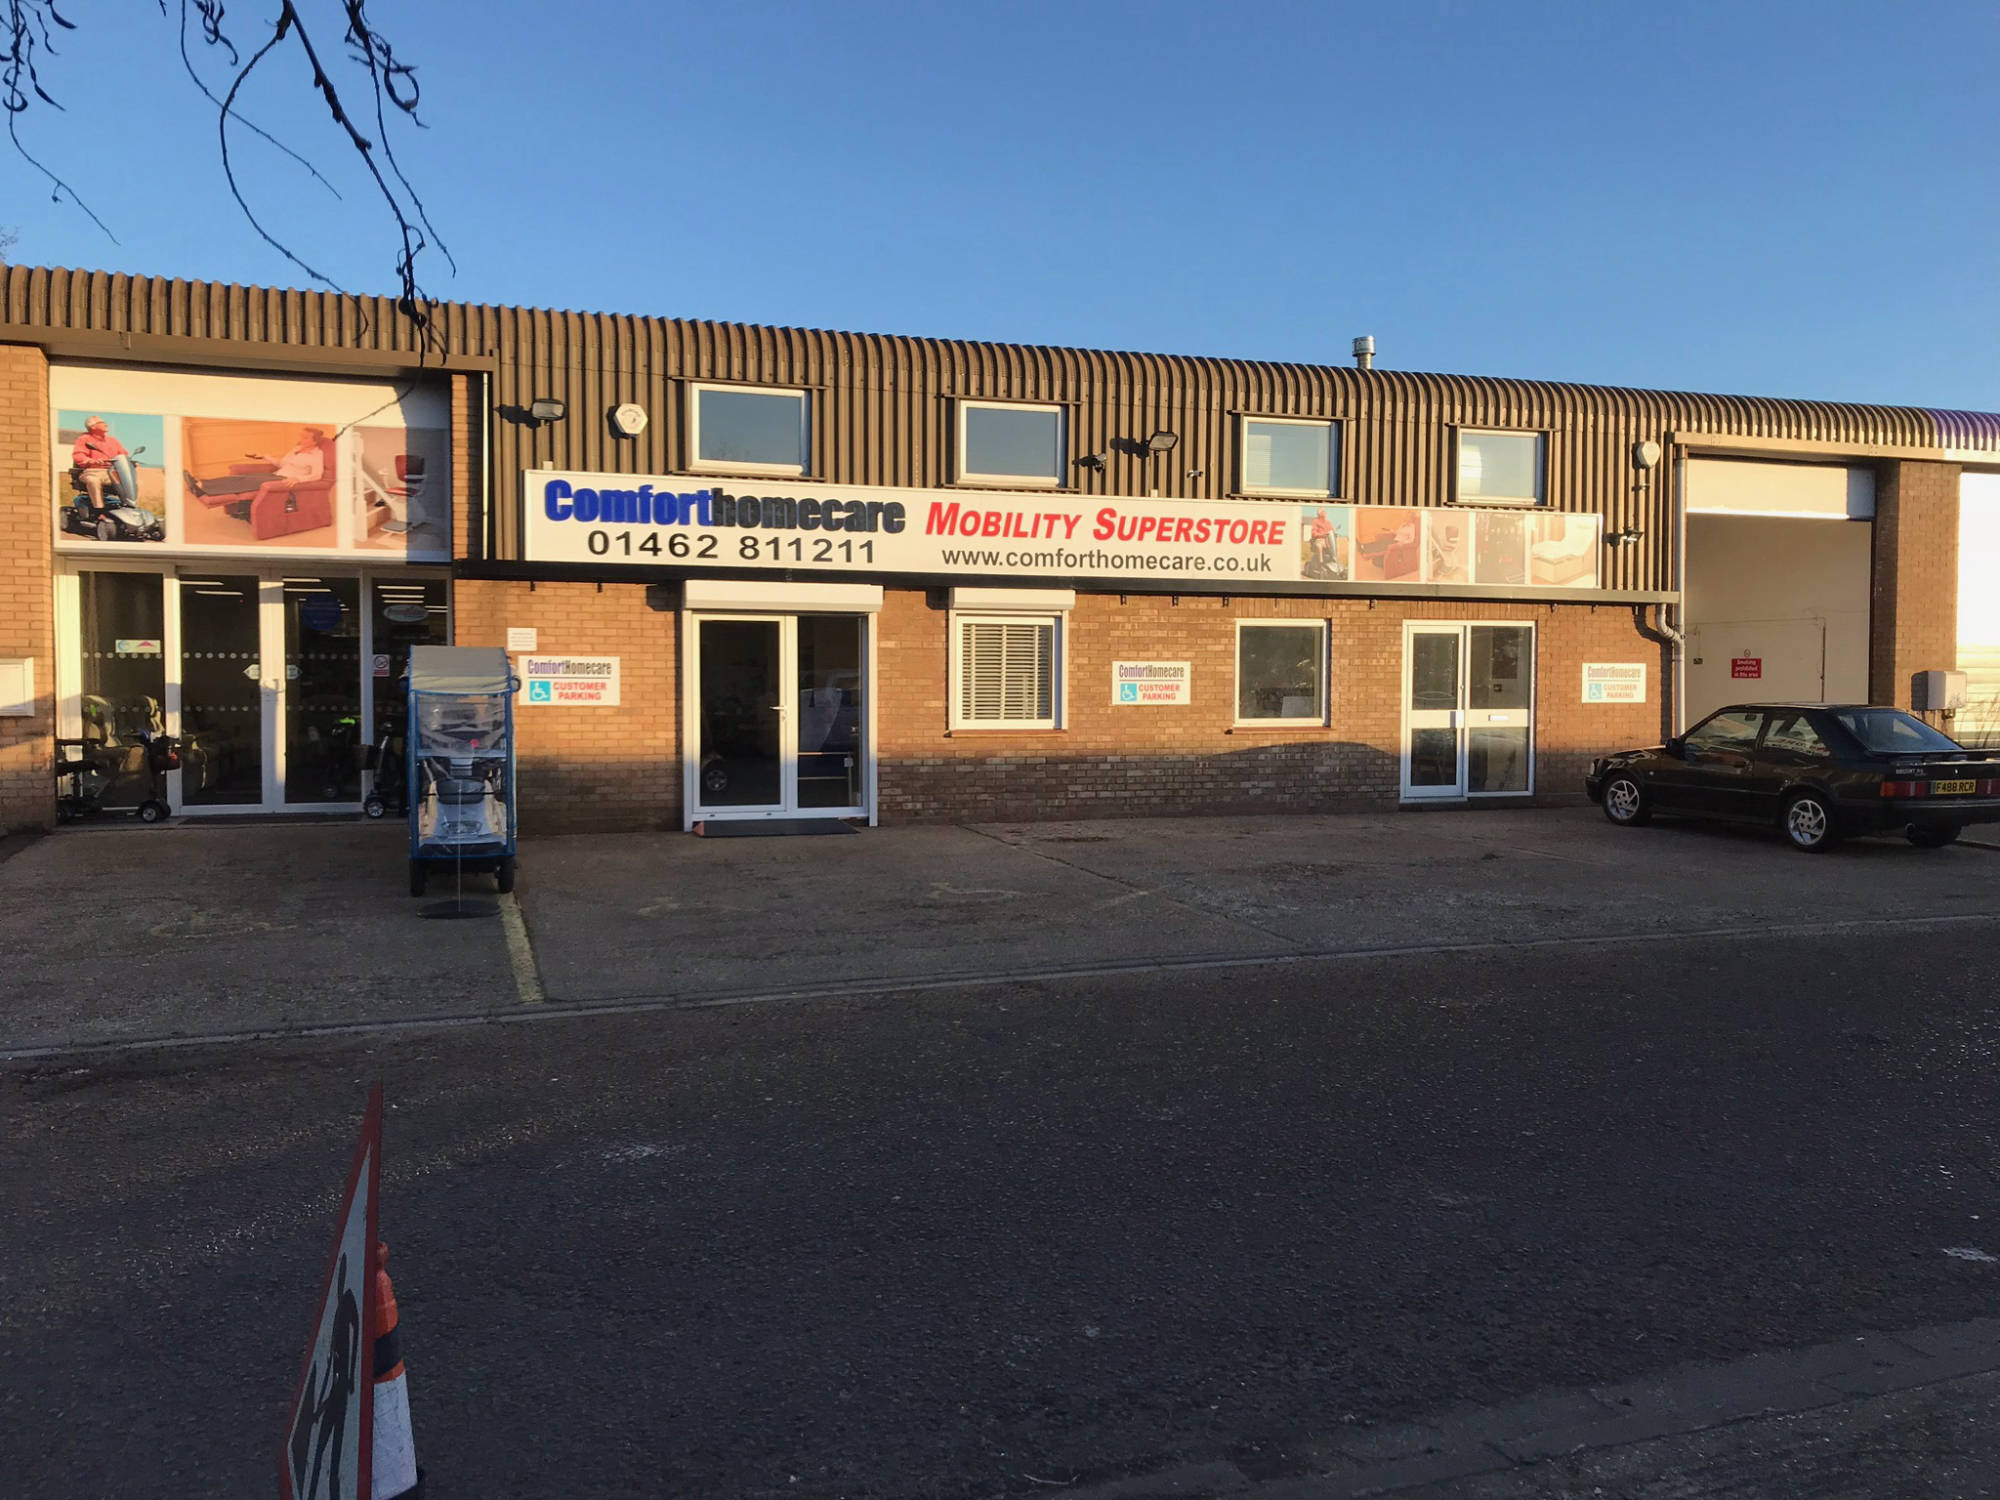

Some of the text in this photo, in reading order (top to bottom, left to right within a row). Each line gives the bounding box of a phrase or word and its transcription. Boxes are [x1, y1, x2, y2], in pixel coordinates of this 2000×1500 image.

[544, 479, 906, 534] Comforthomecare
[925, 501, 1286, 545] MOBILITY SUPERSTORE
[588, 530, 875, 564] 01462 811211
[942, 547, 1272, 573] www.comforthomecare.co.uk
[527, 659, 612, 675] ComfortHomecare
[553, 682, 607, 690] CUSTOMER
[558, 692, 602, 700] PARKING
[1138, 684, 1180, 692] CUSTOMER
